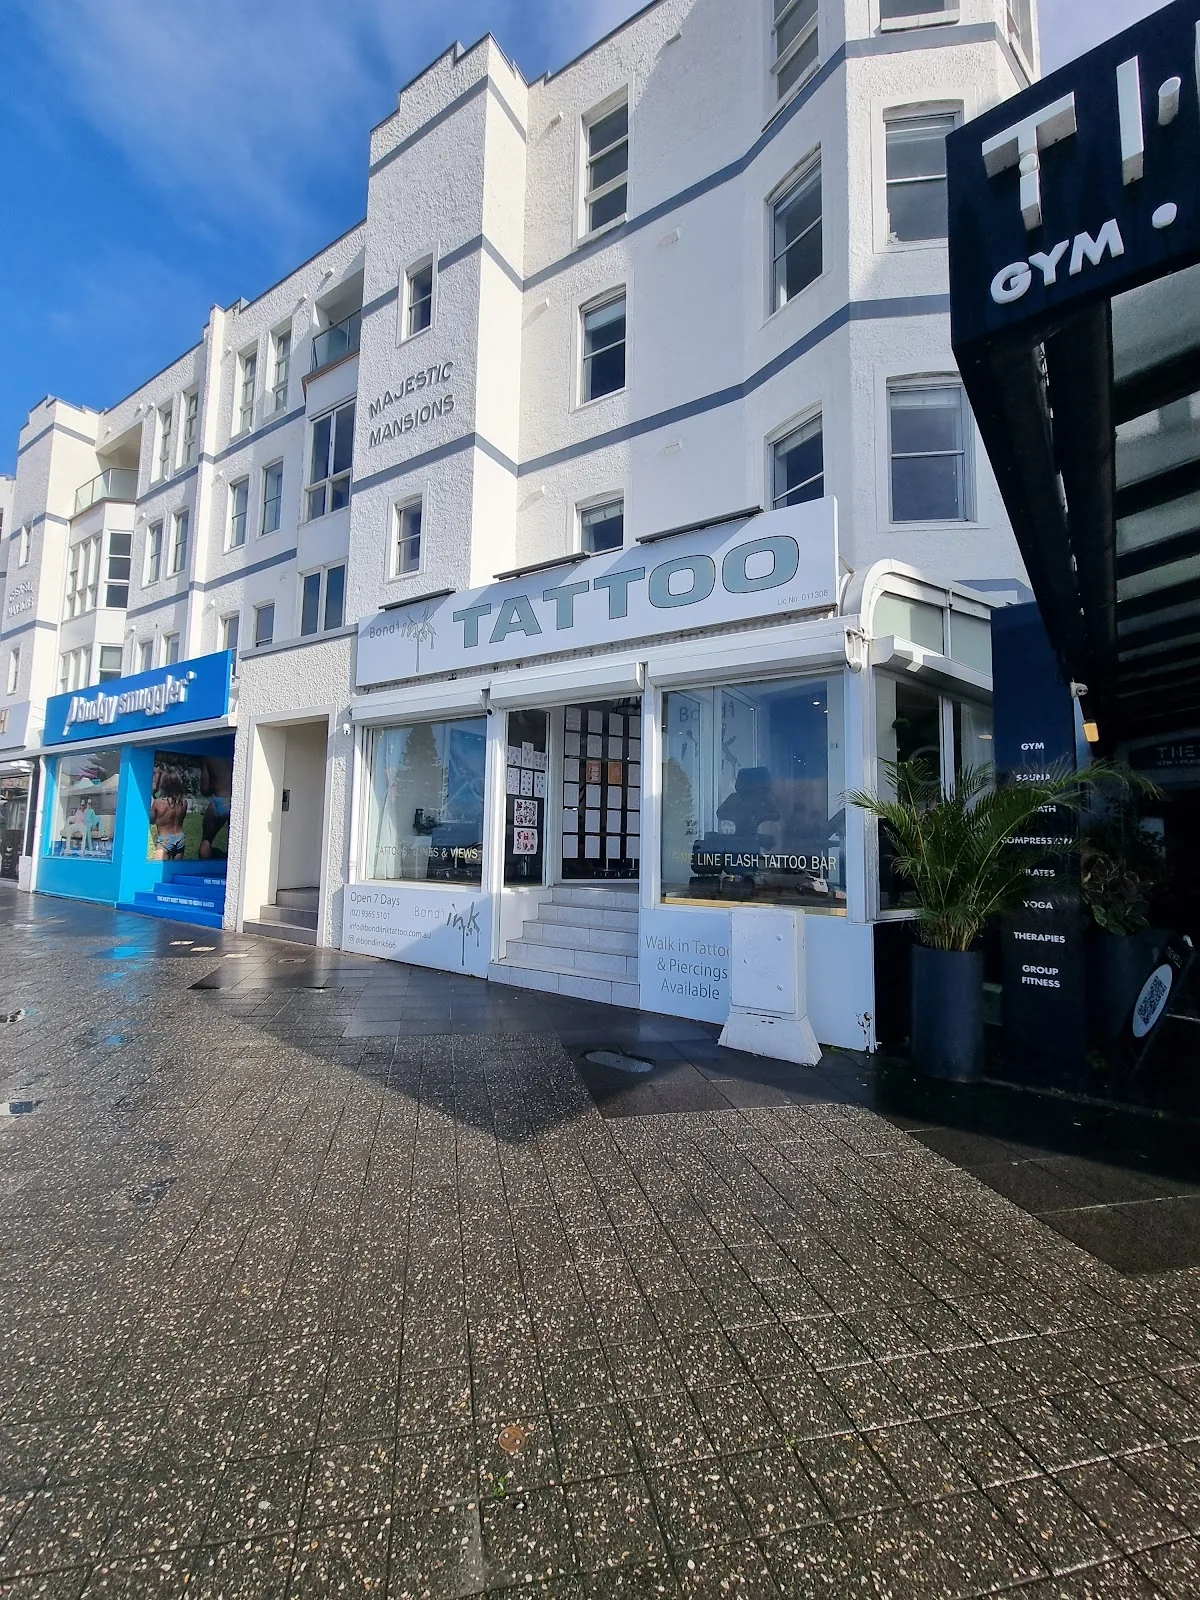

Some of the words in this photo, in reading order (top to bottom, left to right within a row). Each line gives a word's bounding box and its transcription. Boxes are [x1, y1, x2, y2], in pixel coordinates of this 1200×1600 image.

[990, 218, 1124, 304] GYM
[369, 361, 453, 420] MAJESTIC
[369, 394, 455, 448] MANSIONS
[453, 535, 799, 648] TATTOO
[369, 619, 400, 639] Bondi
[1020, 742, 1045, 751] GYM
[1016, 773, 1051, 781] SAUNA
[1032, 805, 1057, 813] ATH
[441, 847, 448, 858] &
[450, 847, 478, 859] VIEWS
[697, 853, 721, 866] LINE
[724, 853, 759, 868] FLASH
[763, 854, 807, 870] TATTOO
[811, 856, 837, 871] BAR
[1022, 868, 1056, 877] ILATES
[350, 891, 372, 904] Open
[374, 894, 379, 903] 7
[380, 894, 400, 908] Days
[1023, 900, 1054, 910] YOGA
[349, 908, 360, 918] (02)
[361, 909, 375, 918] 9365
[377, 911, 390, 920] 5101
[414, 905, 445, 919] Bondi
[645, 935, 675, 951] Walk
[678, 938, 690, 953] in
[1013, 931, 1066, 944] THERAPIES
[657, 957, 666, 971] &
[669, 958, 728, 982] Piercings
[1022, 964, 1059, 976] GROUP
[661, 978, 720, 1000] Available
[1022, 976, 1061, 988] FITNESS
